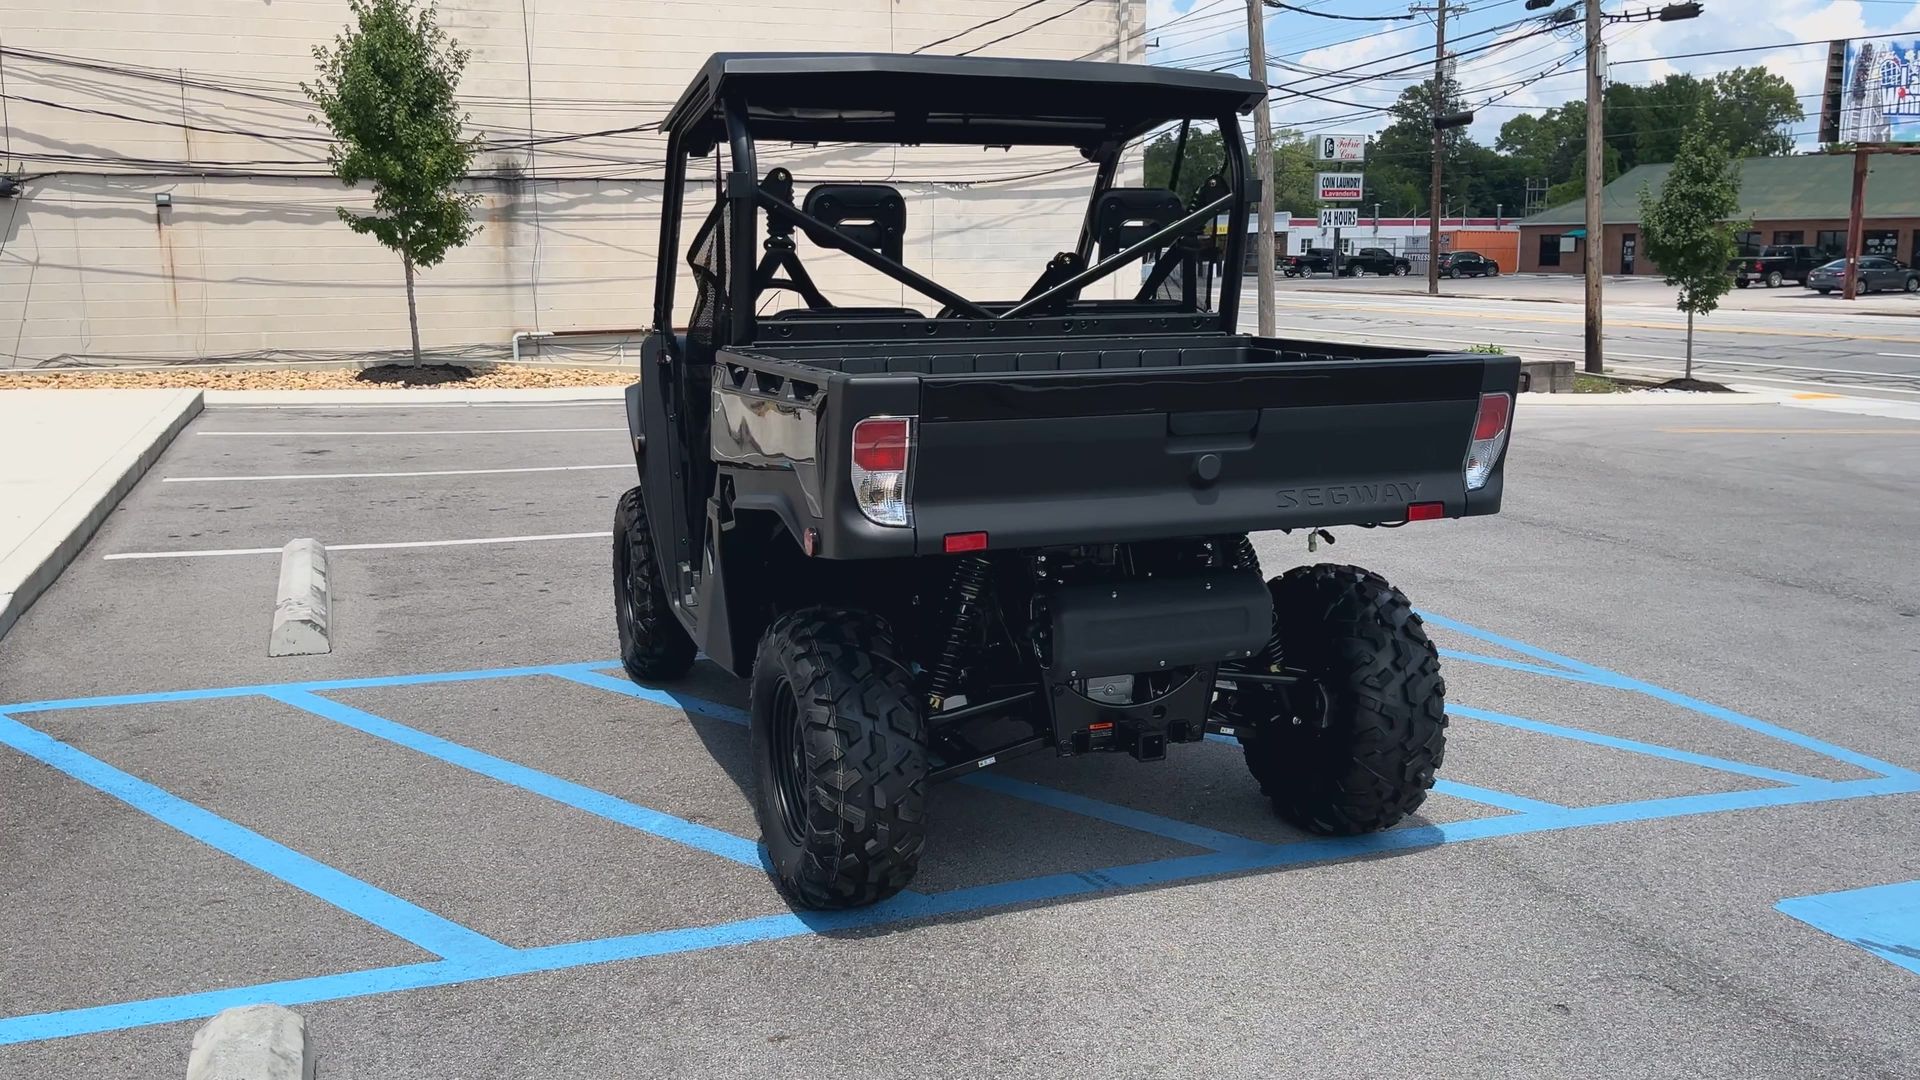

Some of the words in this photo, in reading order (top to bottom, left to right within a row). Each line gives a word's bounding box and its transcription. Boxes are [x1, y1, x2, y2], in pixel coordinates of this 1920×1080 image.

[1337, 137, 1361, 148] Fabric
[1340, 148, 1357, 159] Care
[1322, 176, 1335, 188] COIN
[1336, 176, 1360, 189] LAUNDRY
[1323, 211, 1332, 226] 24
[1334, 211, 1356, 226] HOURS
[1276, 481, 1421, 508] SEGWAY
